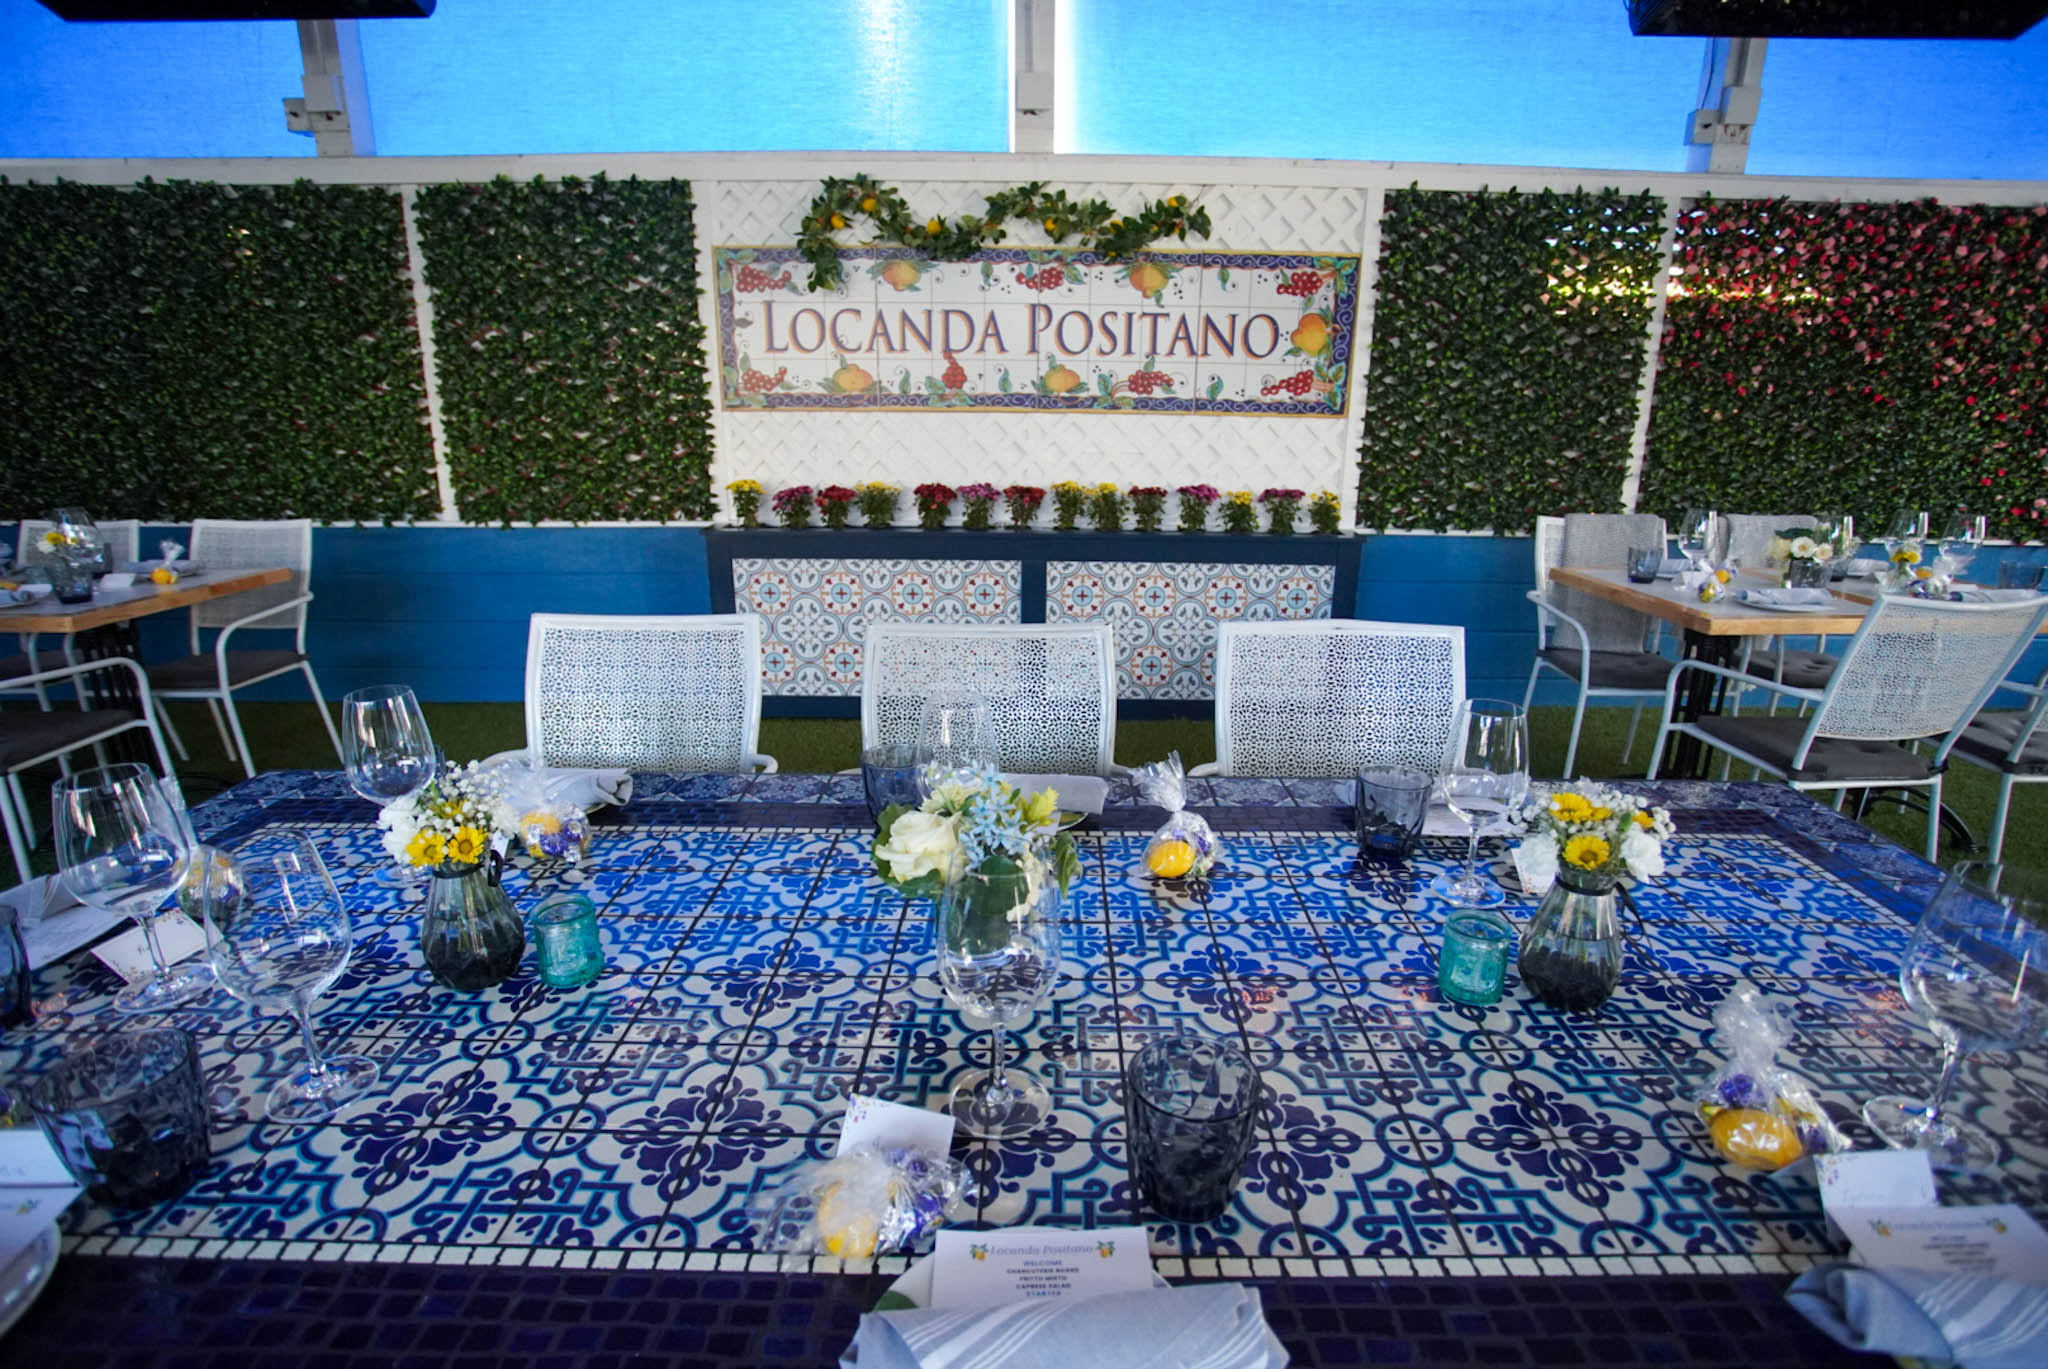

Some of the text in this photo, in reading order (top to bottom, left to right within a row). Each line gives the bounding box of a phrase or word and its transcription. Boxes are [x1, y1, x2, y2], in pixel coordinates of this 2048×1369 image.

[762, 299, 1280, 360] LOCANDA POSITANO
[990, 1244, 1094, 1256] Locanda Positano
[1023, 1259, 1063, 1267] WELCOME
